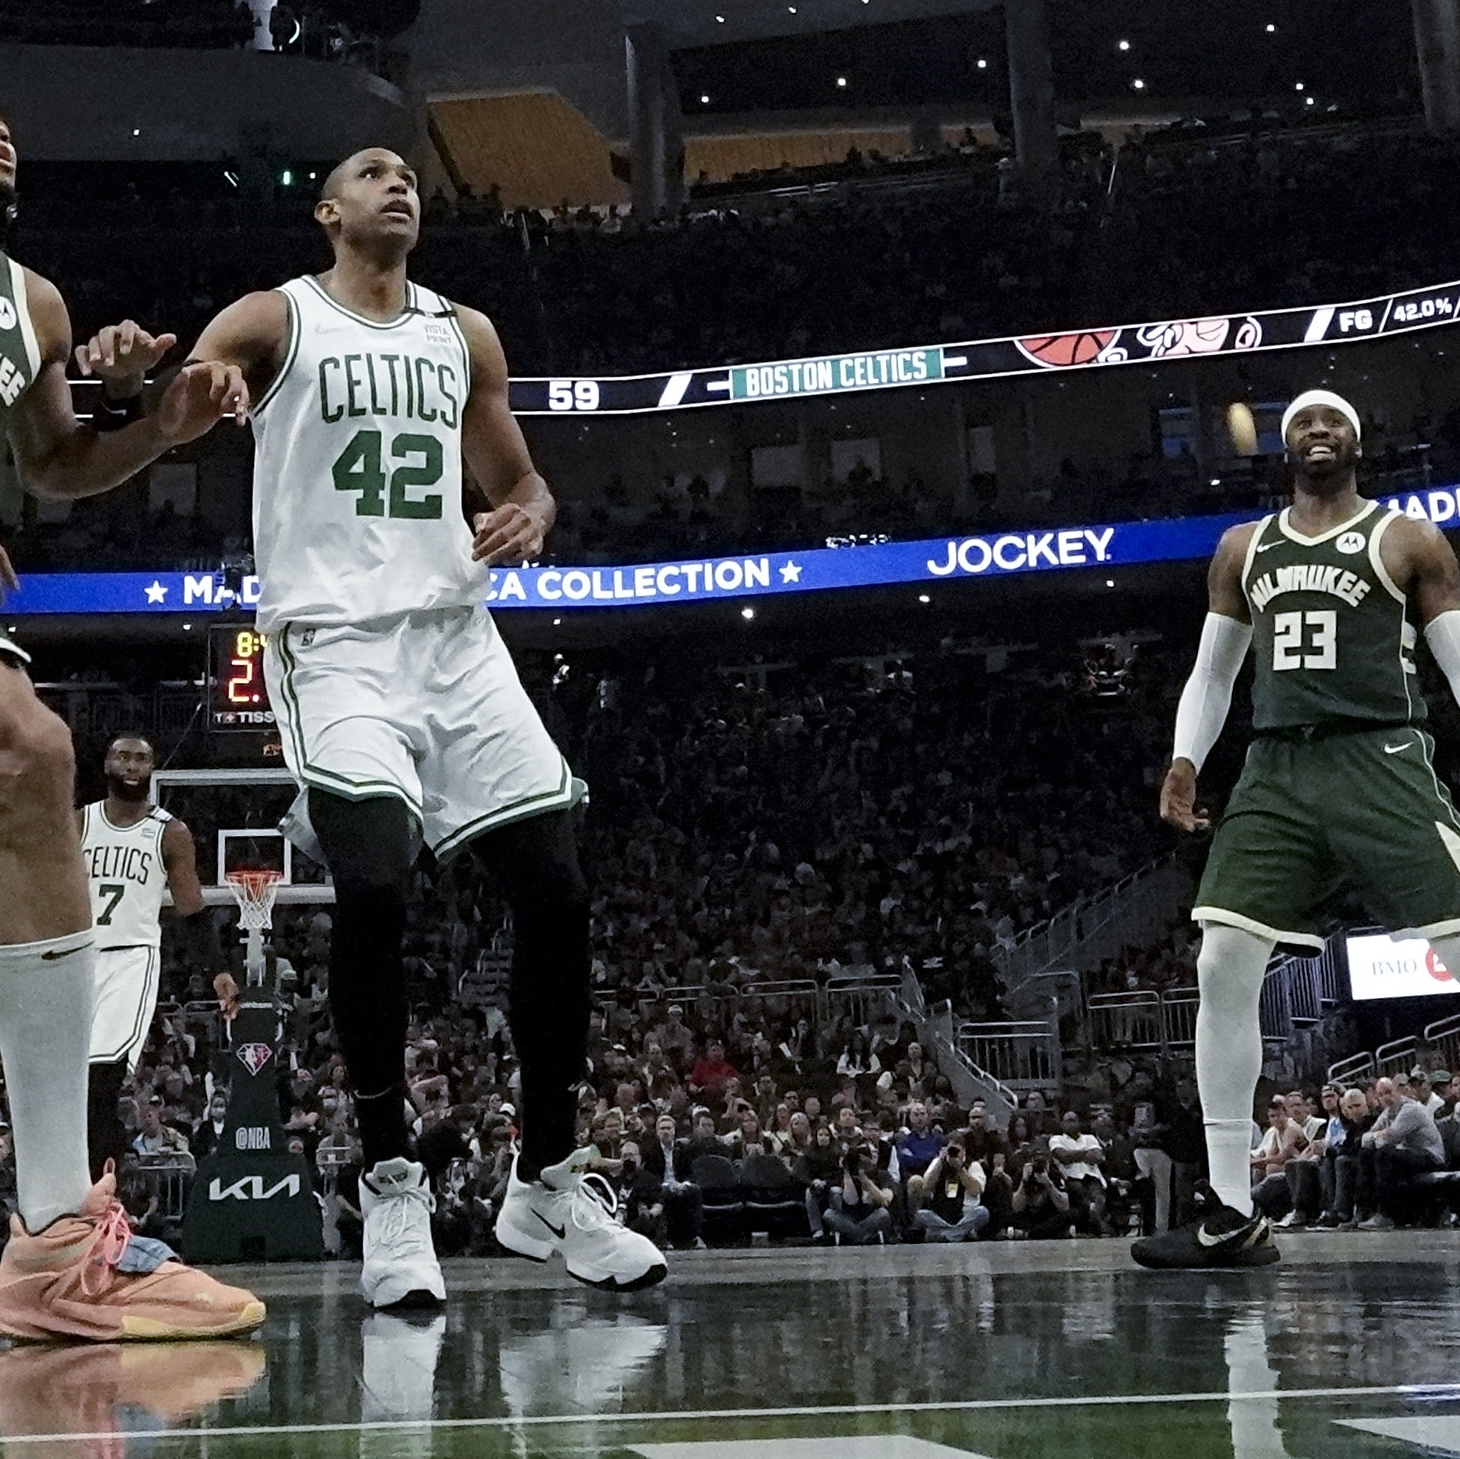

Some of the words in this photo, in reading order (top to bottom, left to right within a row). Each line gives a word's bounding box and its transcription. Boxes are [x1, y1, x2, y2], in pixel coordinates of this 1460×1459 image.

[548, 380, 600, 411] 59
[745, 359, 832, 397] BOSTON
[839, 352, 928, 388] CELTICS
[1339, 309, 1374, 333] FG
[1393, 296, 1453, 322] 42.0%
[318, 353, 457, 430] CELTICS
[331, 430, 444, 520] 42
[536, 557, 771, 601] COLLECTION
[926, 527, 1115, 576] JOCKEY
[1250, 565, 1372, 614] MILWAUKEE
[1272, 610, 1338, 671] 23
[96, 884, 125, 926] 7
[1372, 958, 1418, 977] BMO
[235, 1126, 271, 1150] @NBA
[208, 1173, 301, 1201] KIA
